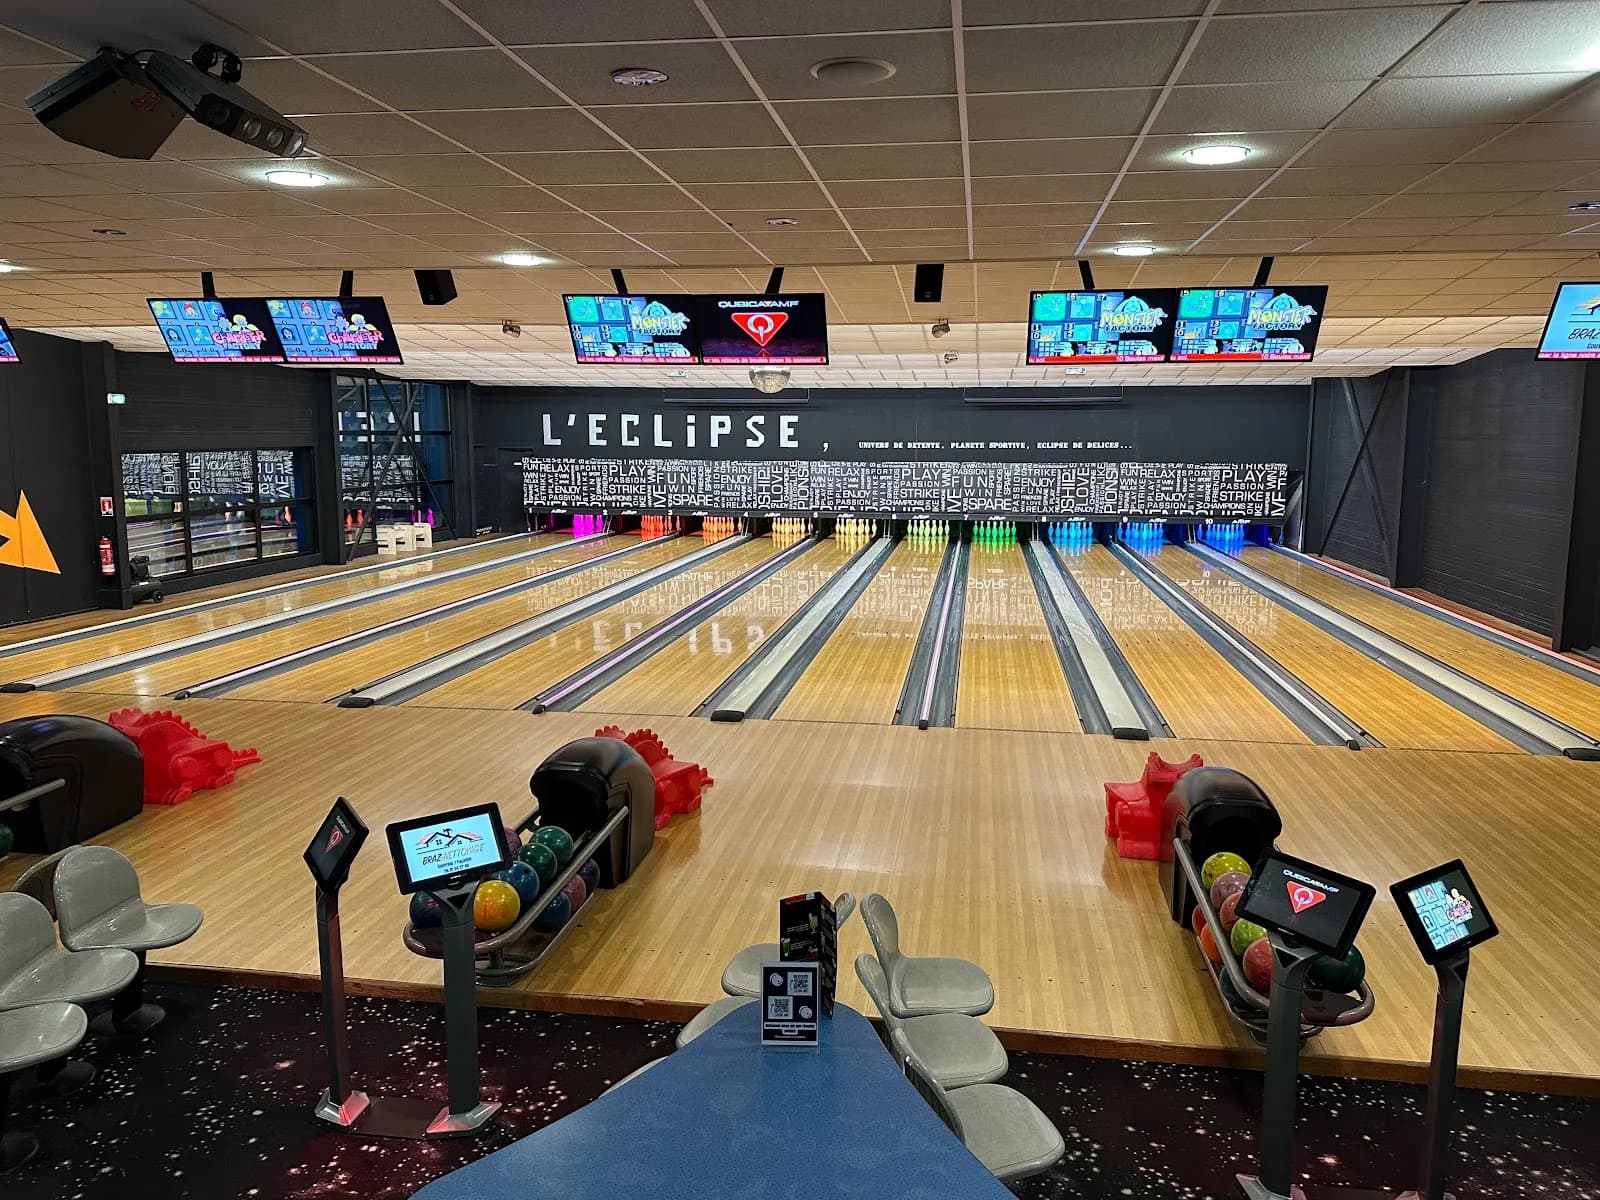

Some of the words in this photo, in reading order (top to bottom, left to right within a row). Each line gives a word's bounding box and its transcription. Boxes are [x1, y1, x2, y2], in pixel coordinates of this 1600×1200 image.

[540, 464, 570, 472] RELAX
[609, 464, 648, 476] PLAY
[828, 468, 860, 476] RELAX
[901, 469, 940, 480] PLAY
[1139, 469, 1175, 478] RELAX
[1222, 470, 1265, 482] PLAY
[657, 473, 690, 484] FUN
[720, 474, 752, 484] ENJOY
[952, 475, 989, 487] FUN
[1021, 478, 1055, 487] ENJOY
[771, 465, 783, 502] LOVE
[1076, 467, 1089, 506] LOVE
[555, 486, 581, 494] ENJOY
[609, 485, 647, 494] STRIKE
[669, 485, 694, 493] WIN
[901, 489, 940, 498] STRIKE
[964, 489, 992, 497] WIN
[843, 490, 871, 498] ENJOY
[1155, 493, 1186, 501] ENJOY
[1220, 492, 1263, 502] STRIKE
[673, 494, 713, 506] SPARE
[968, 499, 1012, 510] SPARE
